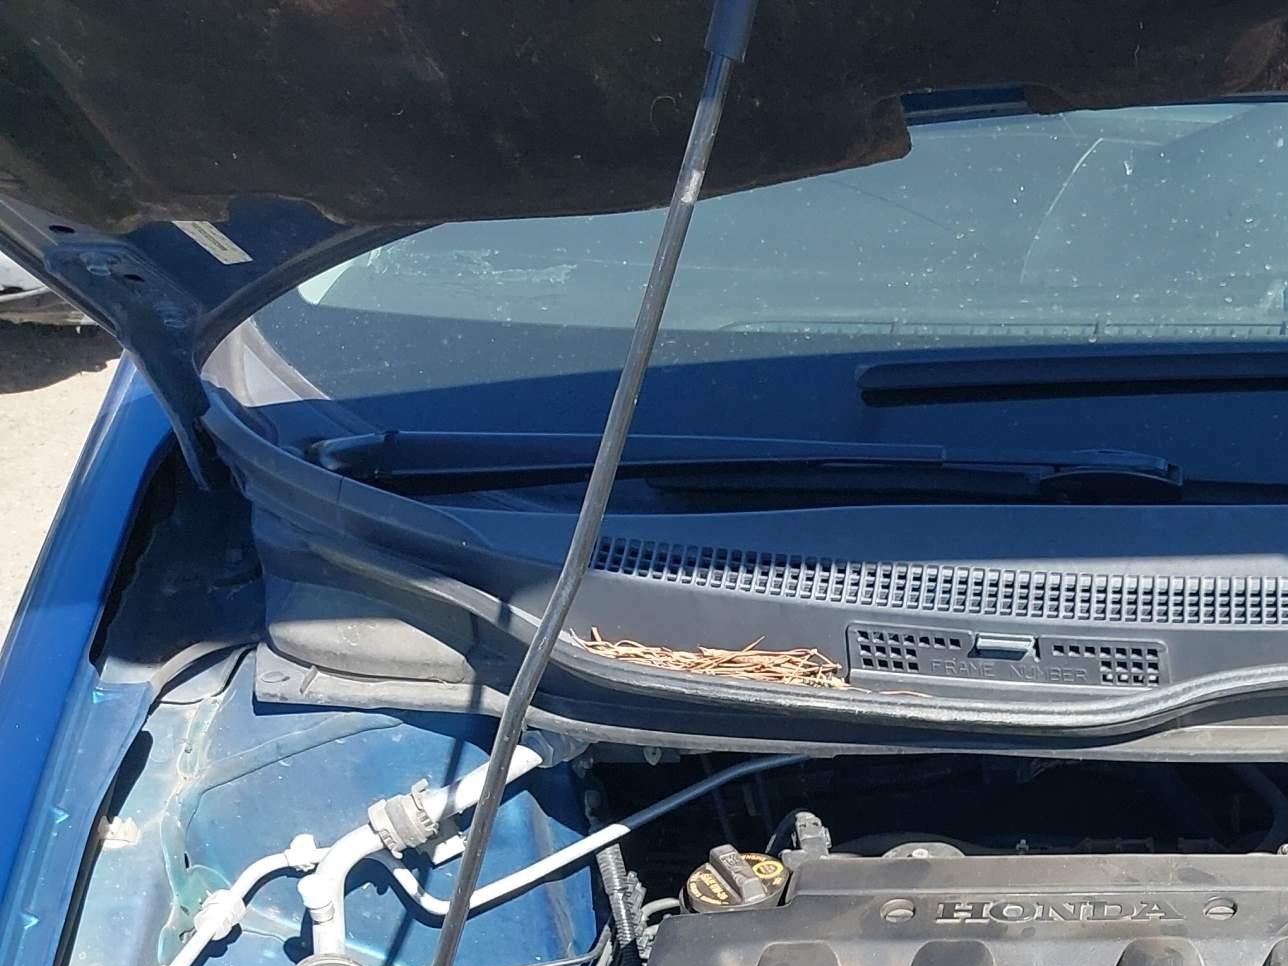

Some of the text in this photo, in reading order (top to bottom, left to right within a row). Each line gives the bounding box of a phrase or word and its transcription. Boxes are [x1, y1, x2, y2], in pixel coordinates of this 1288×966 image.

[929, 658, 1088, 682] FRAME NUMBER
[936, 900, 1186, 923] HONDA
